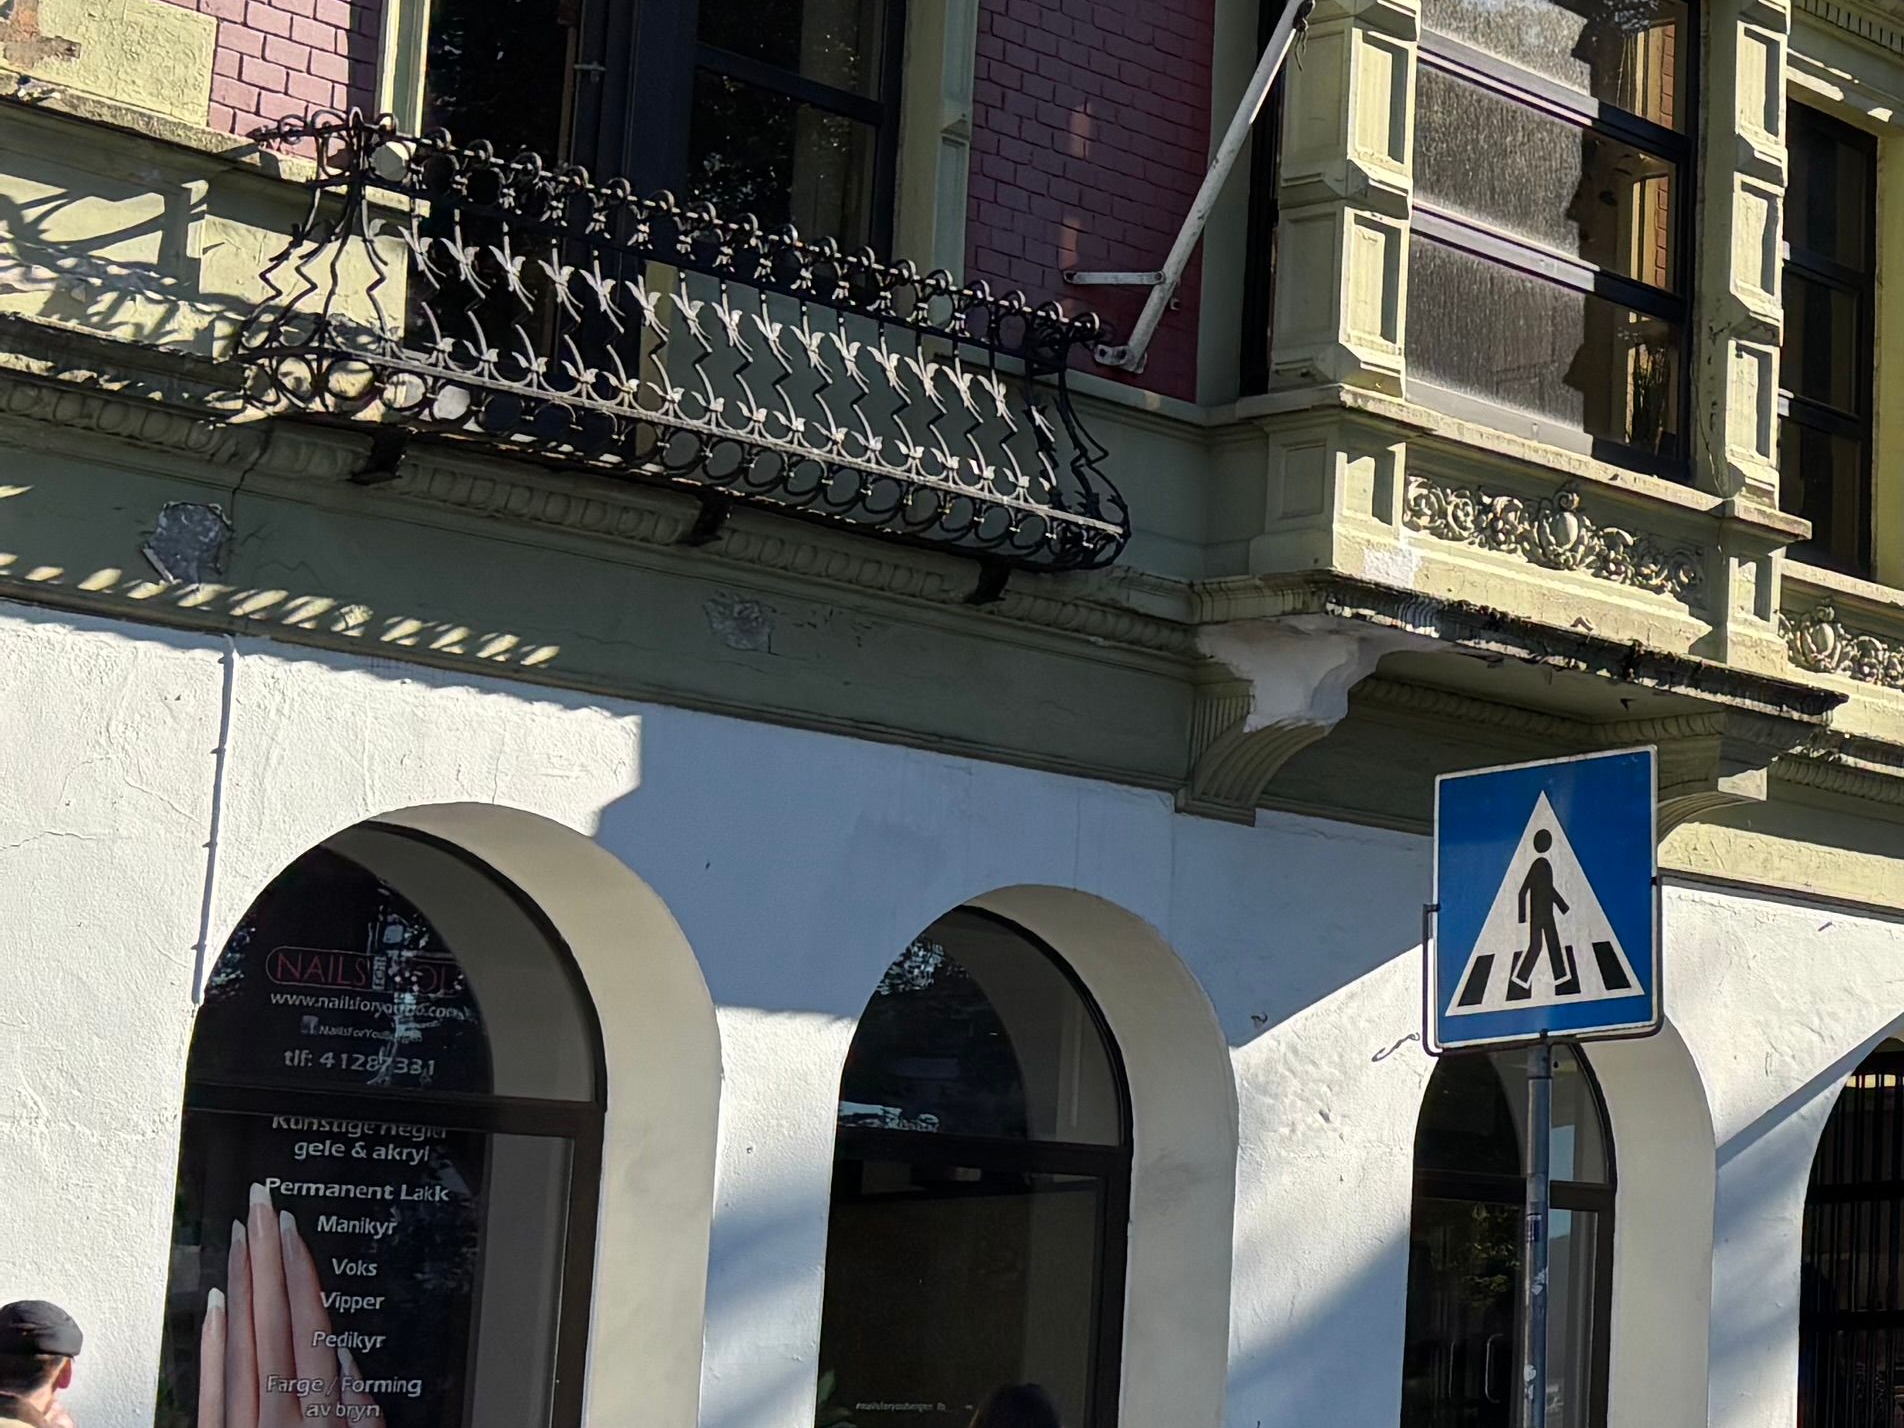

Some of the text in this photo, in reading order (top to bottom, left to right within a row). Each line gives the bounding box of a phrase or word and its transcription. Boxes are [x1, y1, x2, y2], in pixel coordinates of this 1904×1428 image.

[276, 951, 367, 986] NAILS
[284, 1050, 312, 1067] tlf:
[294, 1140, 430, 1165] gele & akryl
[265, 1177, 450, 1201] Permanent Lakk
[317, 1215, 398, 1240] Manikyr
[331, 1258, 378, 1276] Voks
[320, 1291, 385, 1313] Vipper
[312, 1331, 386, 1353] Pedikyr
[267, 1375, 323, 1396] Farge
[341, 1376, 422, 1397] Forming
[306, 1402, 380, 1422] av bryn
